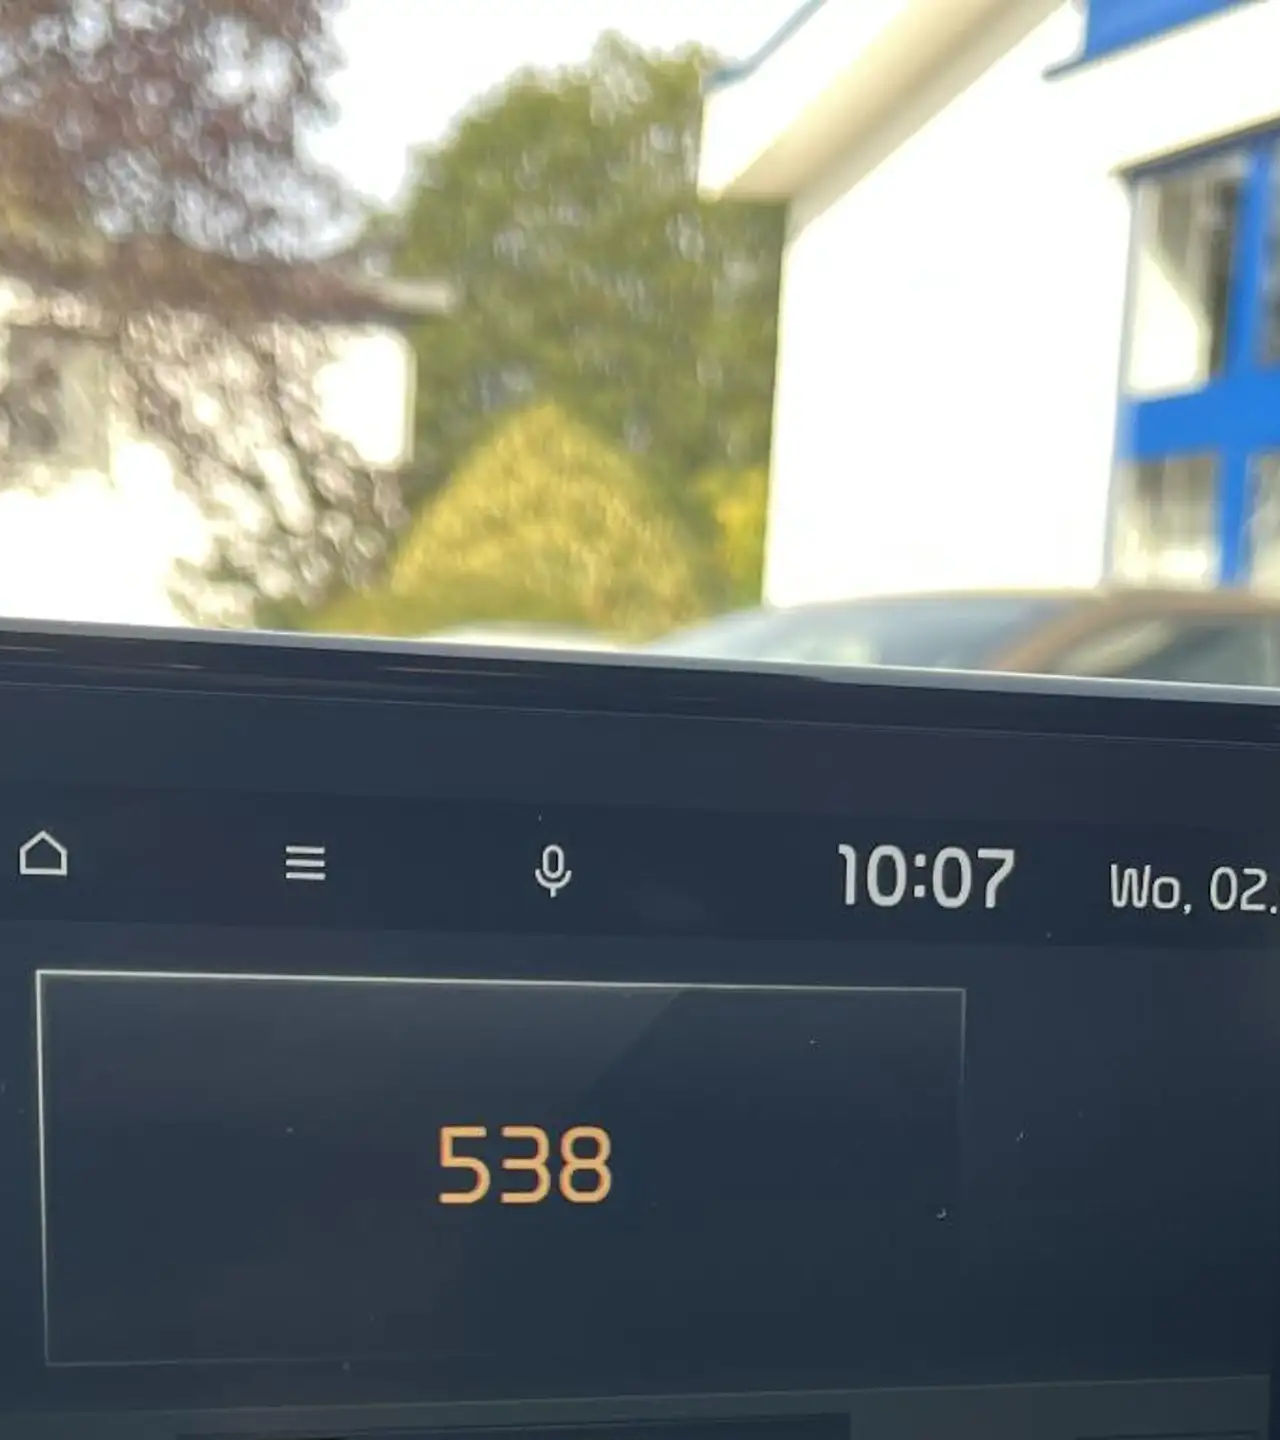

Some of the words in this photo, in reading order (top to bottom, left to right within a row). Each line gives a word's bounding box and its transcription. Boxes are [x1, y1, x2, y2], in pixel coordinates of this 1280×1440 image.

[838, 843, 1015, 909] 10:07
[1110, 863, 1192, 915] Wo,
[439, 1126, 611, 1204] 538
